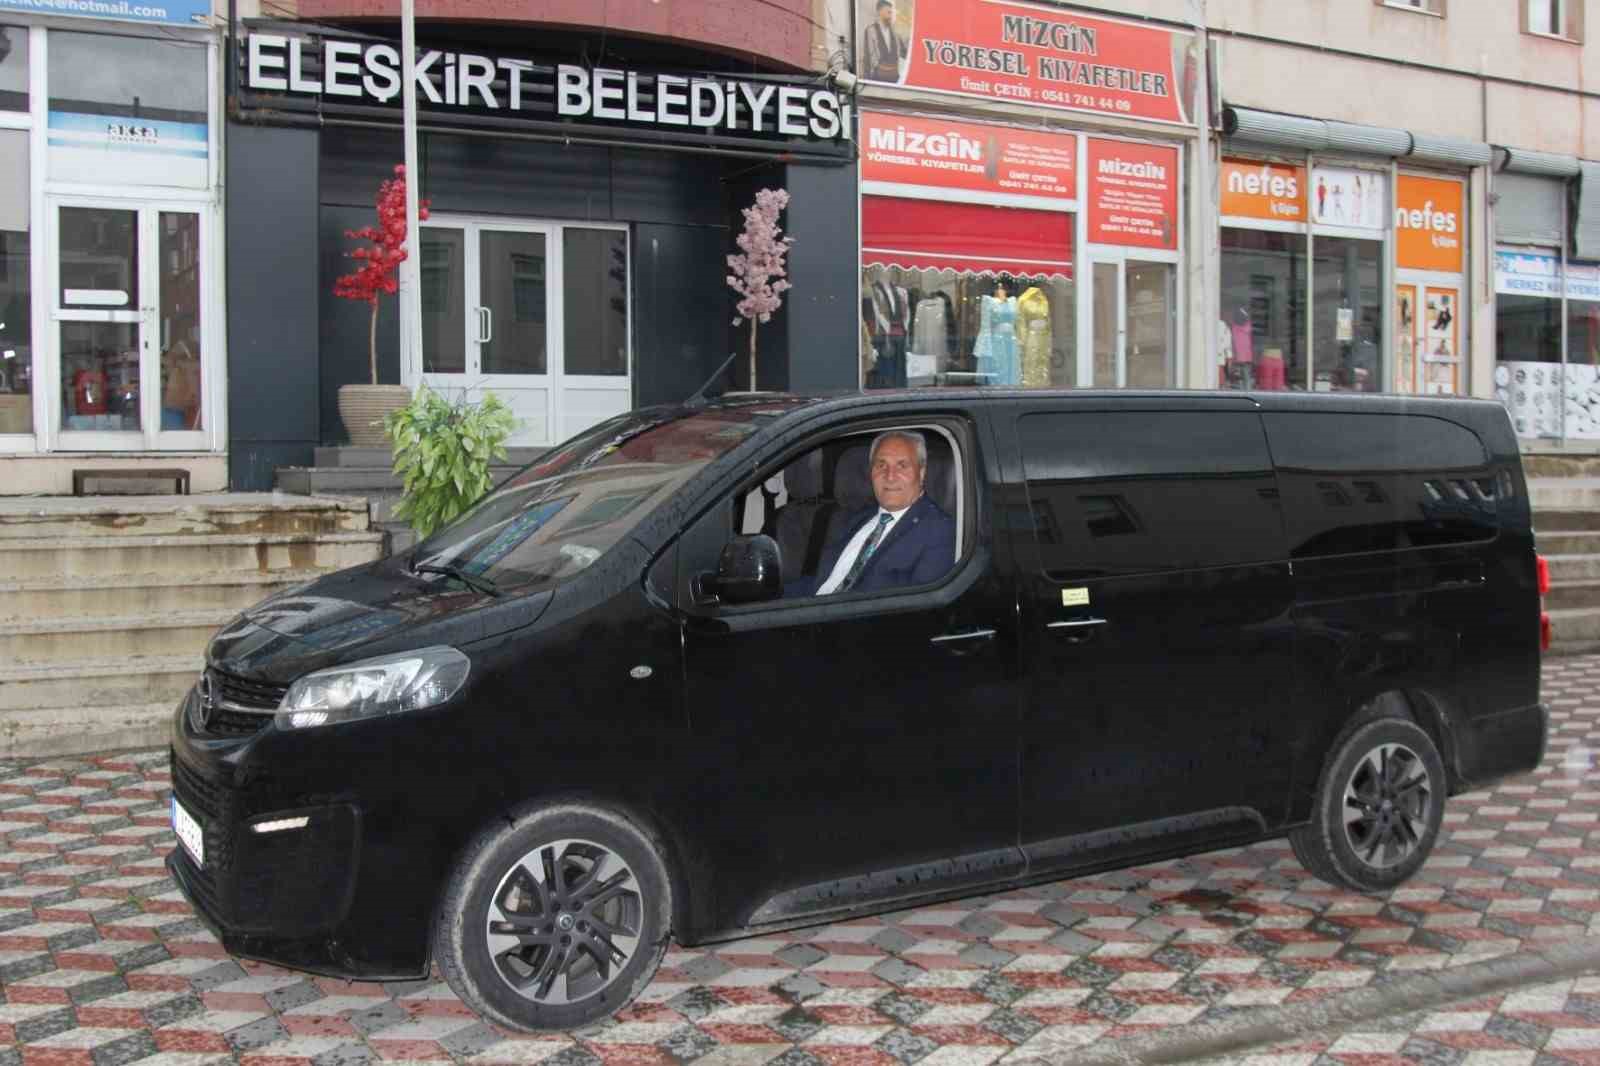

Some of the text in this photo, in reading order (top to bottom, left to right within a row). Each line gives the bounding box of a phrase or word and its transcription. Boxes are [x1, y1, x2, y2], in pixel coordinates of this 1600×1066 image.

[922, 38, 1169, 97] YÖRESEL KIYAFETLER
[960, 77, 990, 93] Ümit
[994, 82, 1032, 97] ÇETİN
[1041, 89, 1071, 104] 0541
[1074, 94, 1094, 106] 741
[866, 151, 918, 166] YÖRESEL
[921, 158, 985, 174] KIYAFETLER
[1228, 166, 1297, 199] nefes
[1396, 201, 1457, 232] nefes
